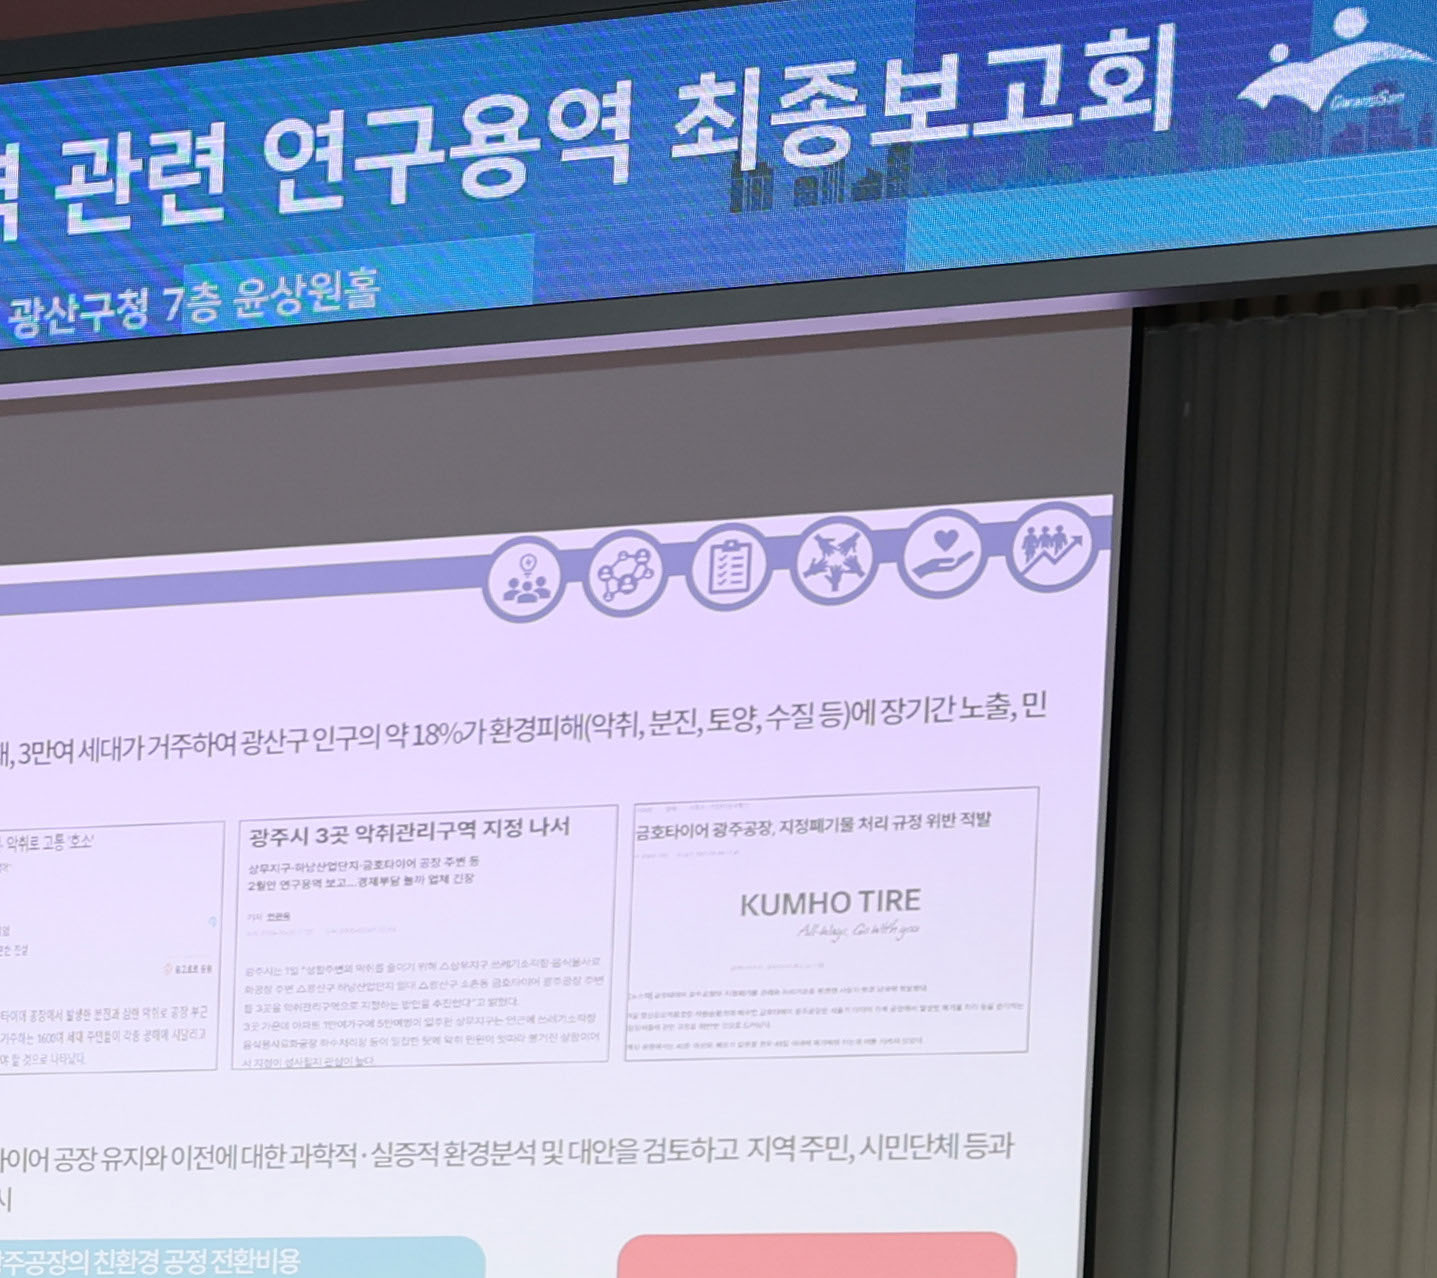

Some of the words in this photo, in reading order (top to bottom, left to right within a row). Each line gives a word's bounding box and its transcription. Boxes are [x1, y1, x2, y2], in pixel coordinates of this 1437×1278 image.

[54, 121, 226, 235] 관련
[263, 79, 632, 215] 연구용역
[671, 21, 1176, 175] 최종보고회
[7, 280, 149, 340] 광산구청
[162, 271, 222, 331] 7층
[232, 265, 381, 320] 윤상원홀
[17, 737, 74, 766] 3만여
[77, 734, 145, 763] 세대가
[147, 730, 236, 760] 거주하여
[240, 727, 309, 756] 광산구
[312, 723, 380, 752] 인구의
[385, 721, 410, 749] 약
[412, 718, 487, 746] 18%가
[489, 710, 645, 744] 환경피해(악취,
[648, 707, 703, 738] 분진,
[706, 704, 762, 735] 토양,
[765, 701, 814, 731] 수질
[818, 698, 876, 730] 등)에
[880, 694, 957, 726] 장기간
[959, 691, 1017, 722] 노출,
[1022, 689, 1046, 718] 민
[249, 826, 308, 848] 광주시
[315, 825, 350, 845] 3곳
[355, 819, 476, 844] 악취관리구역
[482, 817, 523, 839] 지정
[529, 815, 570, 837] 나서
[741, 890, 851, 917] KUMHO
[857, 887, 921, 913] TIRE
[53, 1146, 99, 1173] 공장
[100, 1144, 168, 1172] 유지와
[171, 1143, 237, 1171] 이전에
[241, 1143, 288, 1170] 대한
[443, 1138, 536, 1167] 환경분석
[541, 1138, 563, 1166] 및
[568, 1137, 640, 1165] 대안을
[642, 1135, 739, 1165] 검토하고
[747, 1134, 796, 1163] 지역
[799, 1133, 855, 1164] 주민,
[859, 1132, 959, 1161] 시민단체
[963, 1131, 1015, 1160] 등과
[93, 1247, 159, 1276] 친환경
[162, 1247, 207, 1276] 공정
[210, 1247, 301, 1275] 전환비용
